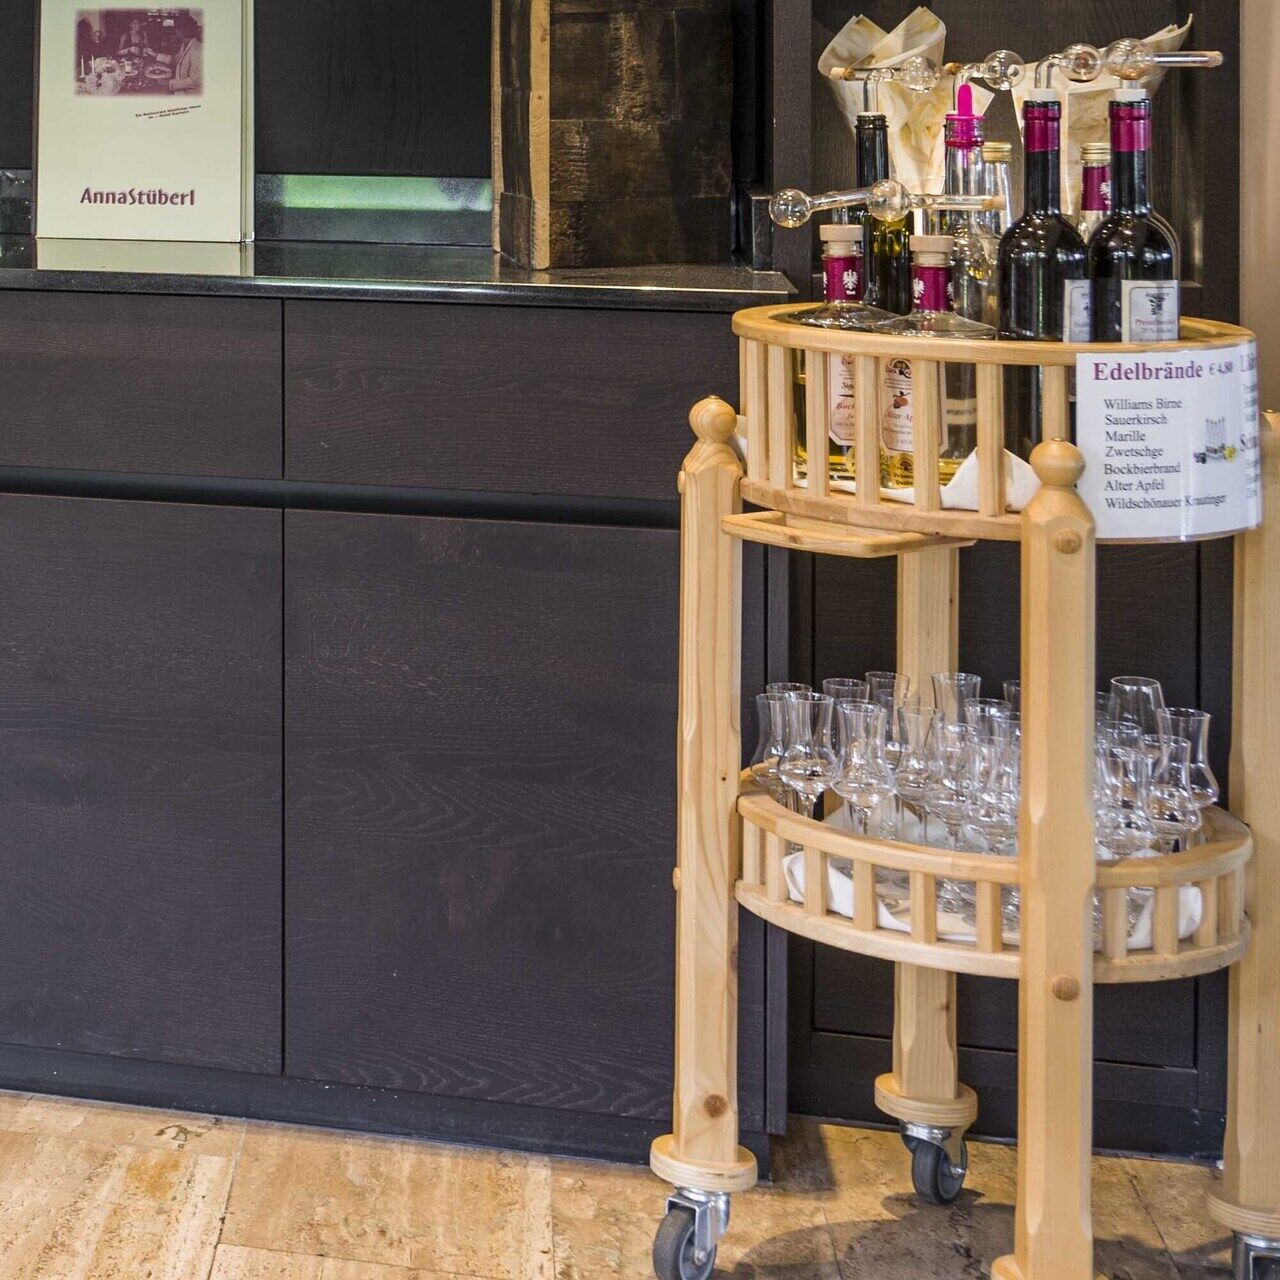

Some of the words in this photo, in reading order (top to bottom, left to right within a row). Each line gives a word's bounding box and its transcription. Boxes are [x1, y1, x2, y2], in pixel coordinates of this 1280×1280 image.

[79, 186, 196, 206] AnnaStüberl
[1092, 360, 1203, 382] Edelbrände
[1103, 398, 1154, 410] Williams
[1155, 397, 1183, 409] Birne
[1104, 413, 1168, 426] Sauerkirsch
[1105, 430, 1146, 442] Marille
[1105, 445, 1164, 460] Zwetschge
[1103, 462, 1182, 475] Bockbierbrand
[1104, 479, 1134, 492] Alter
[1135, 478, 1165, 494] Apfel
[1105, 497, 1182, 509] Wildschönauer
